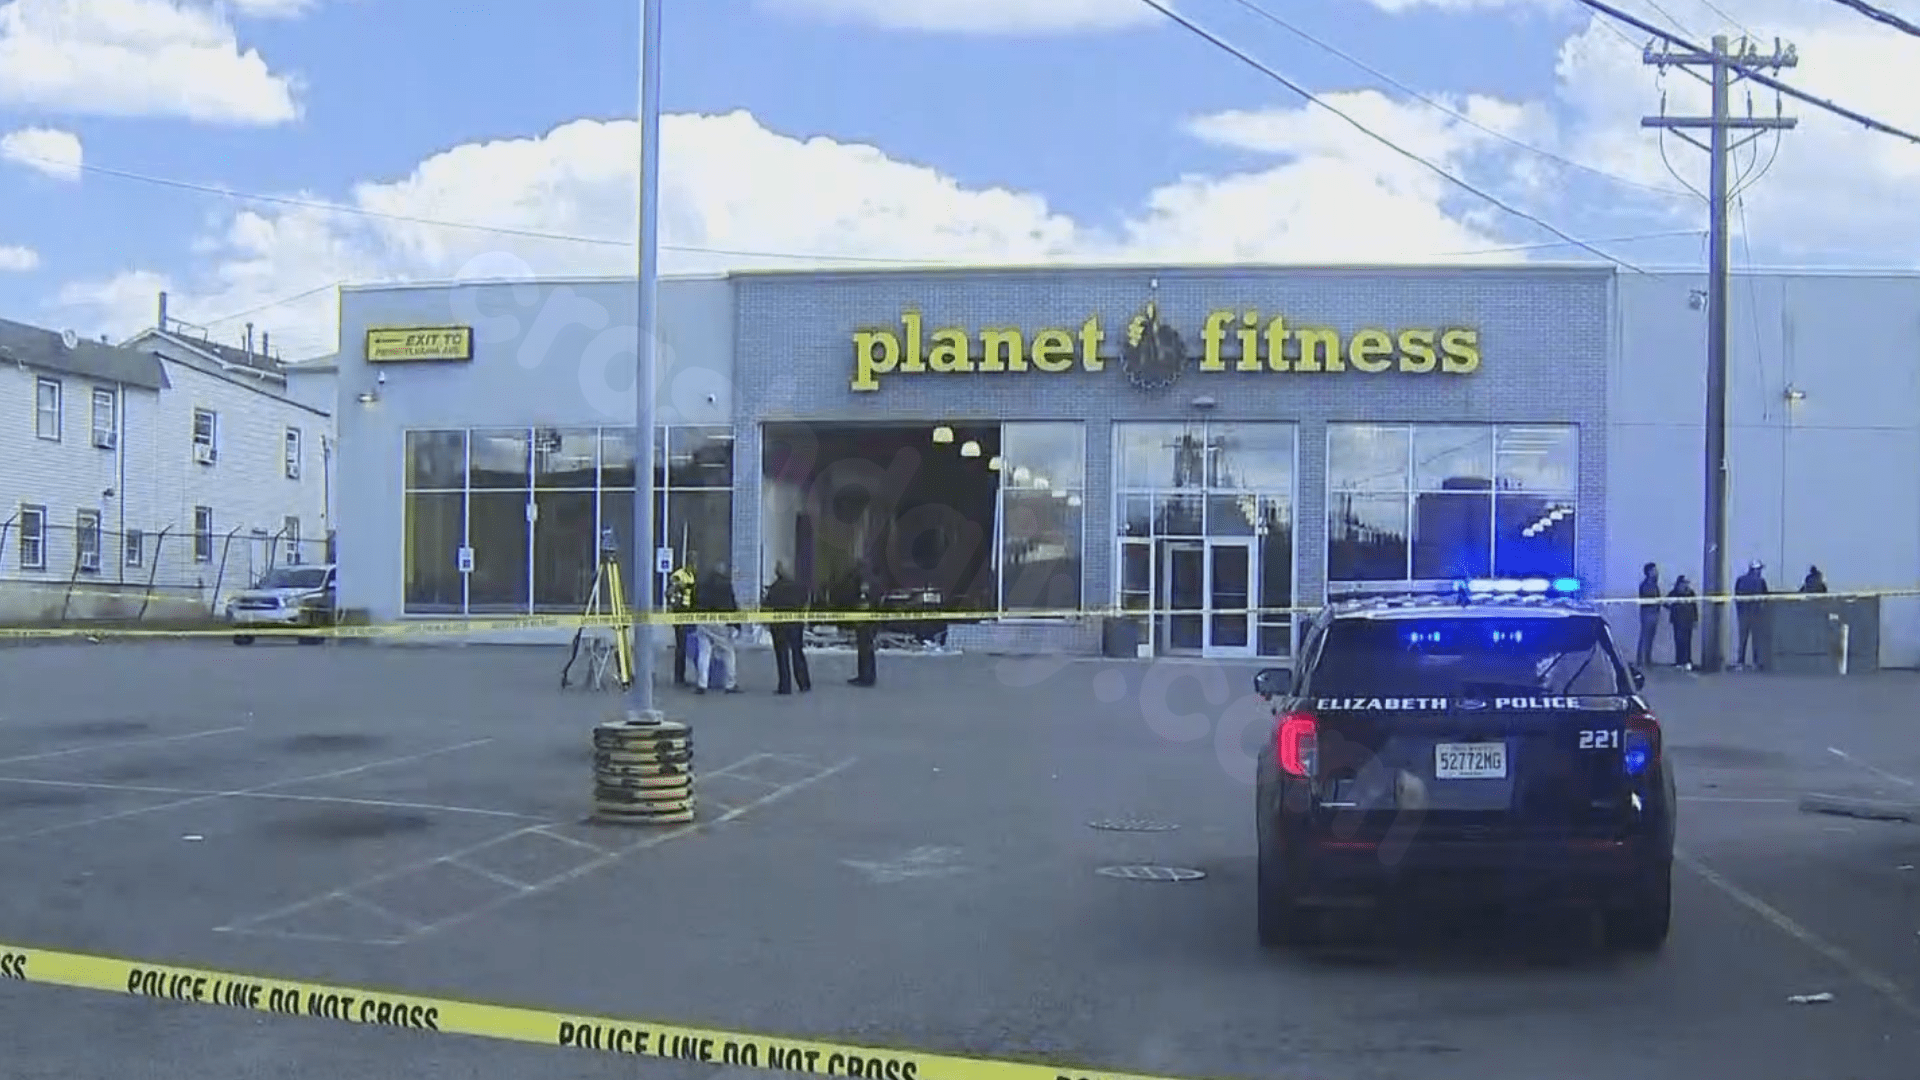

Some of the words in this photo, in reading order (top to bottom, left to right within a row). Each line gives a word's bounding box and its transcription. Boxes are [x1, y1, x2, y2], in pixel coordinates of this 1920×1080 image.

[405, 334, 438, 346] EXIT
[444, 333, 462, 345] TO
[851, 310, 1104, 391] planet
[1199, 310, 1479, 373] fitness
[1316, 697, 1447, 710] ELIZABETH
[1495, 696, 1580, 709] POLICE
[1579, 729, 1618, 749] 221
[1440, 752, 1501, 770] 52772MG
[127, 968, 207, 1001] POLICE
[213, 980, 262, 1009] LINE
[307, 991, 355, 1022] NOT
[360, 999, 439, 1031] CROSS
[559, 1021, 649, 1055] POLICE
[658, 1033, 714, 1062] LINE
[767, 1044, 820, 1073] NOT
[828, 1052, 917, 1080] CROSS
